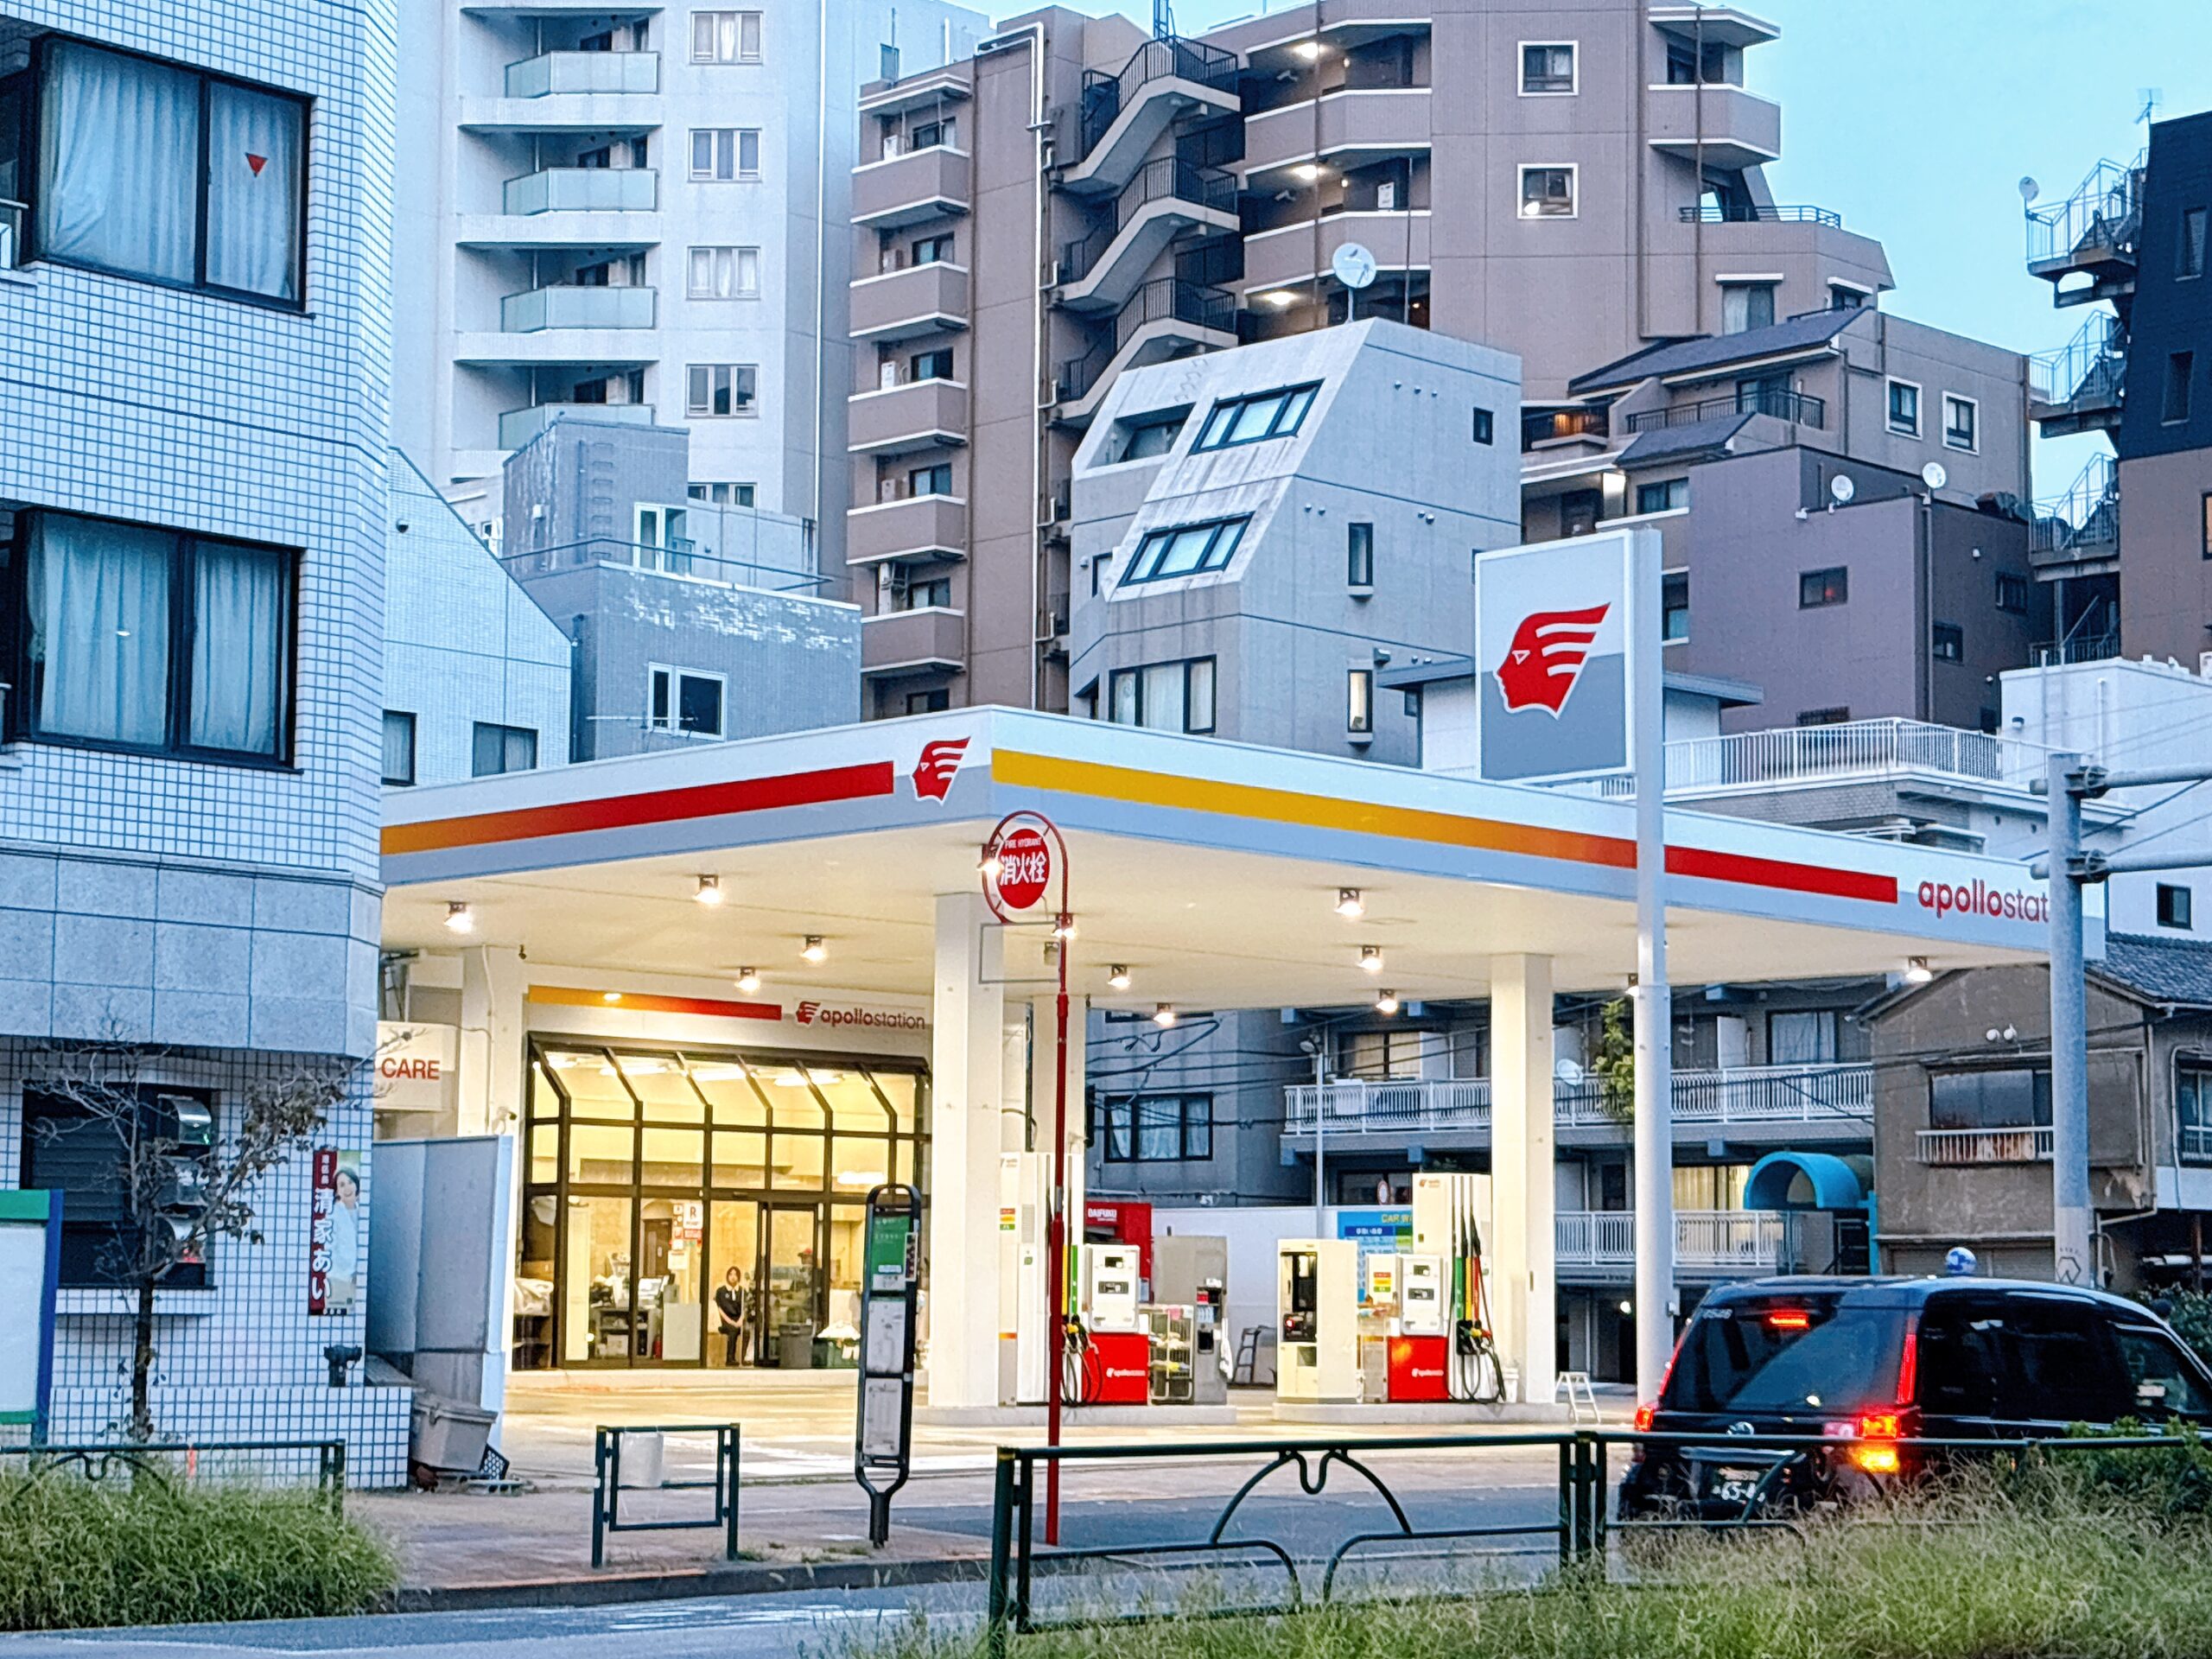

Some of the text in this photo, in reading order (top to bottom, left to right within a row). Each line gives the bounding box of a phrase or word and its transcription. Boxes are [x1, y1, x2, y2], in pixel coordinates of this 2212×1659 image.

[999, 850, 1046, 886] 消火栓
[1917, 877, 2050, 924] apollostat
[821, 1007, 925, 1030] apollostation
[381, 1057, 441, 1080] CARE
[311, 1187, 335, 1300] 清家あい
